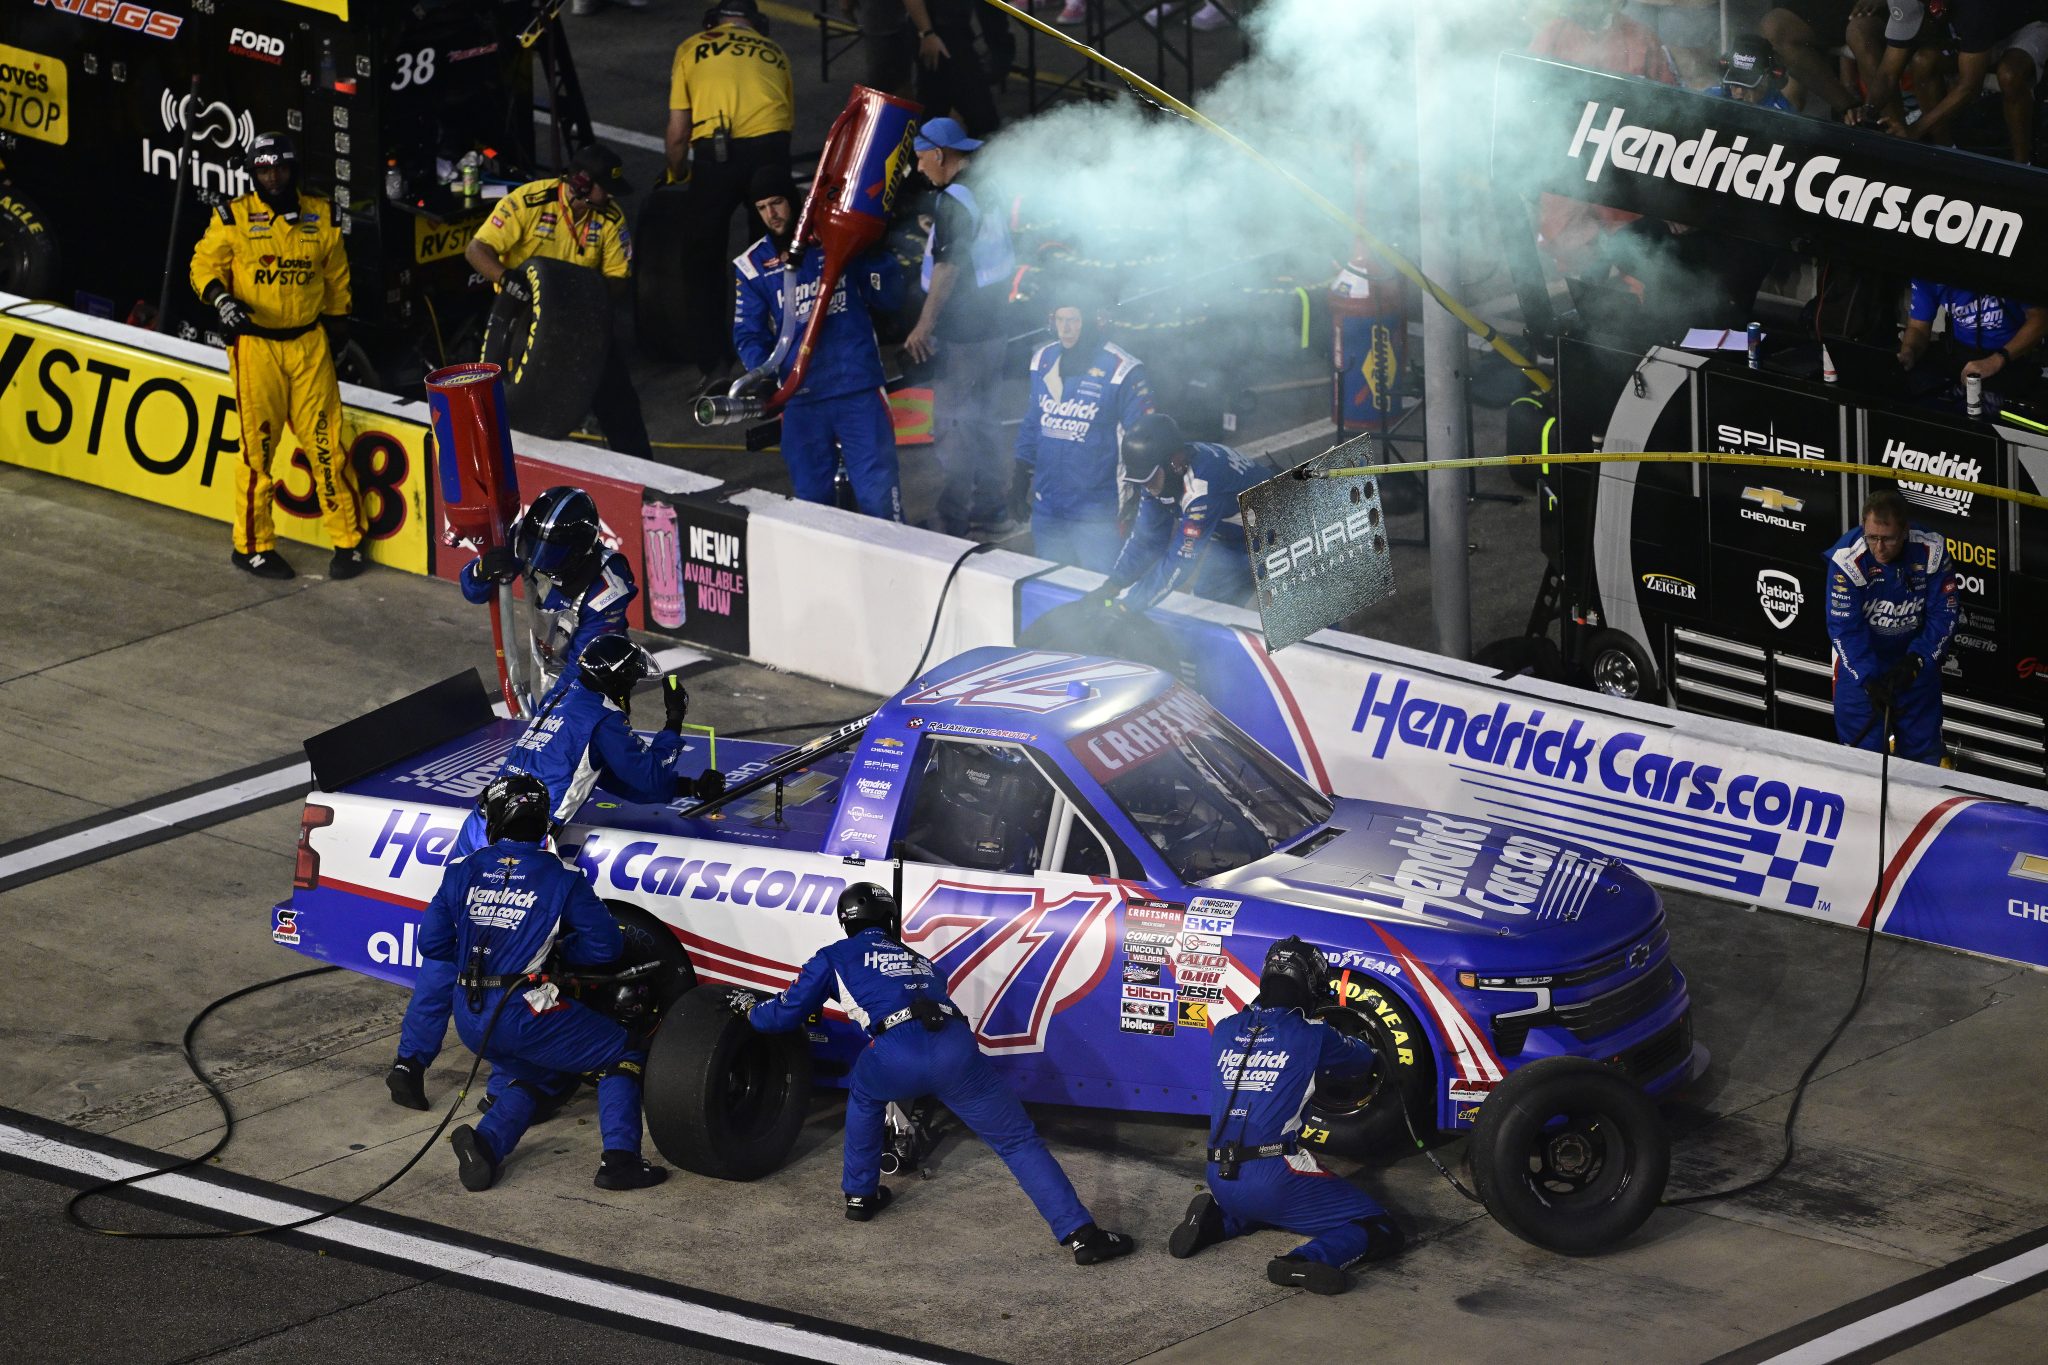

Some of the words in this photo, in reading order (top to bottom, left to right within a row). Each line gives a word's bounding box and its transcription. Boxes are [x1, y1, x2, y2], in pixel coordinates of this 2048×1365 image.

[230, 27, 284, 57] FORD
[391, 47, 435, 91] 38
[1039, 394, 1100, 421] Hendrick
[1717, 420, 1825, 461] SPIRE
[1881, 438, 1982, 483] Hendrick
[1740, 508, 1806, 532] CHEVROLET
[689, 525, 740, 569] NEW!
[1266, 509, 1371, 580] SPIRE
[684, 562, 744, 594] AVAILABLE
[1646, 575, 1696, 600] ZEIGLER
[698, 584, 731, 616] NOW
[1756, 580, 1805, 604] Nations
[1760, 594, 1799, 615] Guard
[1954, 634, 1998, 652] COMETIC
[871, 747, 904, 756] CHEVROLET
[857, 778, 892, 791] Hendrick
[840, 828, 878, 842] Garner
[465, 885, 538, 909] Hendrick
[1204, 899, 1235, 909] NASCAR
[1128, 908, 1182, 922] CRAFTSMAN
[1190, 905, 1209, 913] RACE
[1210, 907, 1233, 916] TRUCK
[1186, 918, 1231, 932] SKF
[1126, 930, 1176, 944] COMETIC
[1125, 944, 1164, 956] LINCOLN
[1132, 954, 1167, 964] WELDERS
[902, 879, 1118, 1052] 71
[1176, 953, 1229, 968] CALICO
[1126, 986, 1171, 1000] tilton
[1177, 986, 1224, 999] JESEL
[1121, 1017, 1155, 1034] Holley
